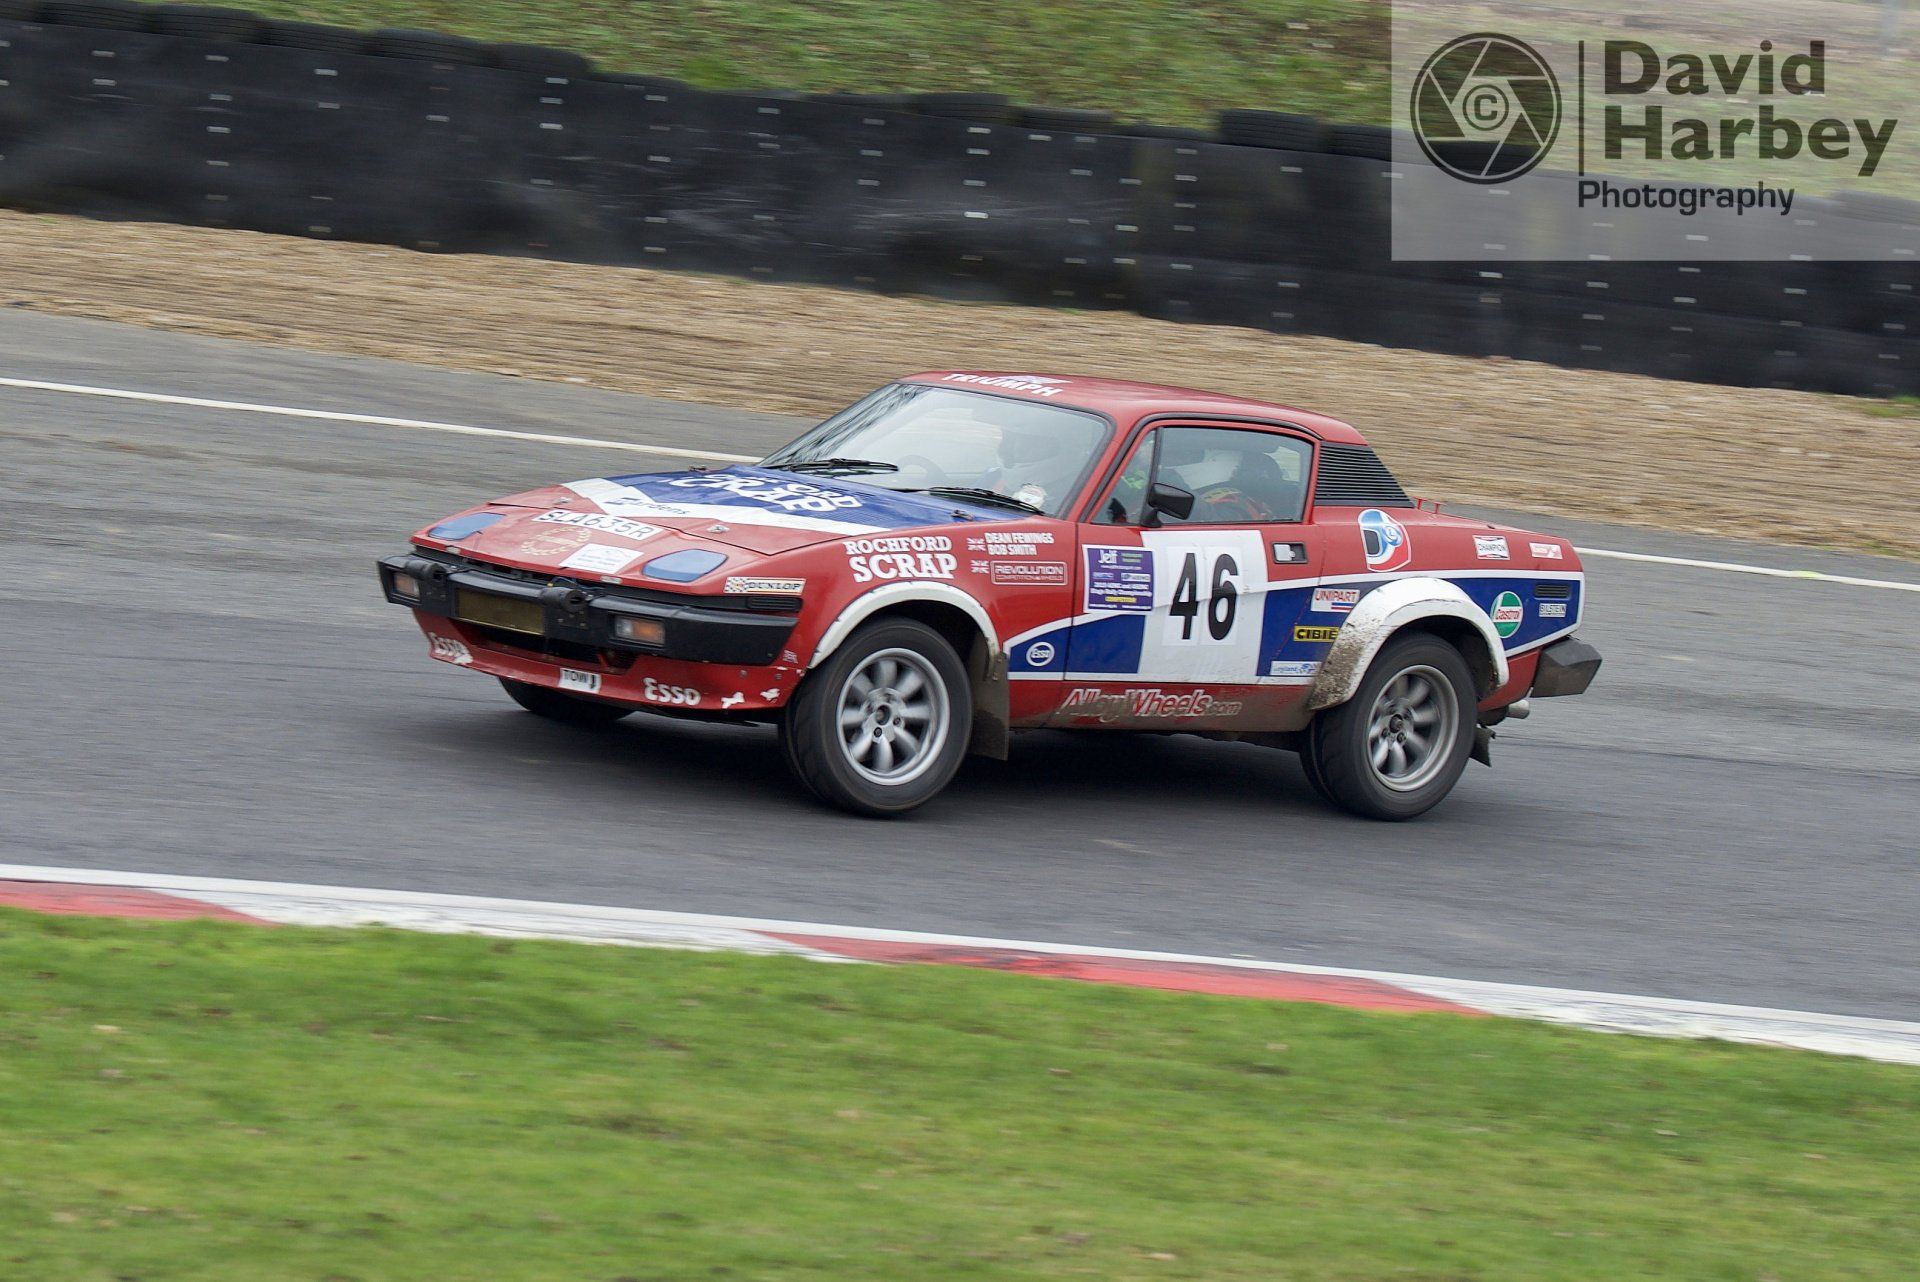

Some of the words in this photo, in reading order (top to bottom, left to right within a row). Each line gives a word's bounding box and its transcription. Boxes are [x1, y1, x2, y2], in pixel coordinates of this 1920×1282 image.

[941, 373, 1064, 397] TRIUMPH
[660, 478, 838, 512] CRAP
[539, 511, 655, 538] SLA635R
[842, 536, 952, 554] ROCHFORD
[984, 532, 1012, 544] DEAN
[987, 544, 1008, 556] BOB
[1007, 544, 1037, 555] SMITH
[848, 553, 958, 582] SCRAP
[995, 565, 1064, 575] REVOLUTION
[745, 581, 801, 590] DUNLOP
[1169, 552, 1239, 641] 46
[1315, 590, 1357, 601] UNIPART
[1495, 608, 1520, 620] Castrol
[563, 669, 588, 684] TOW
